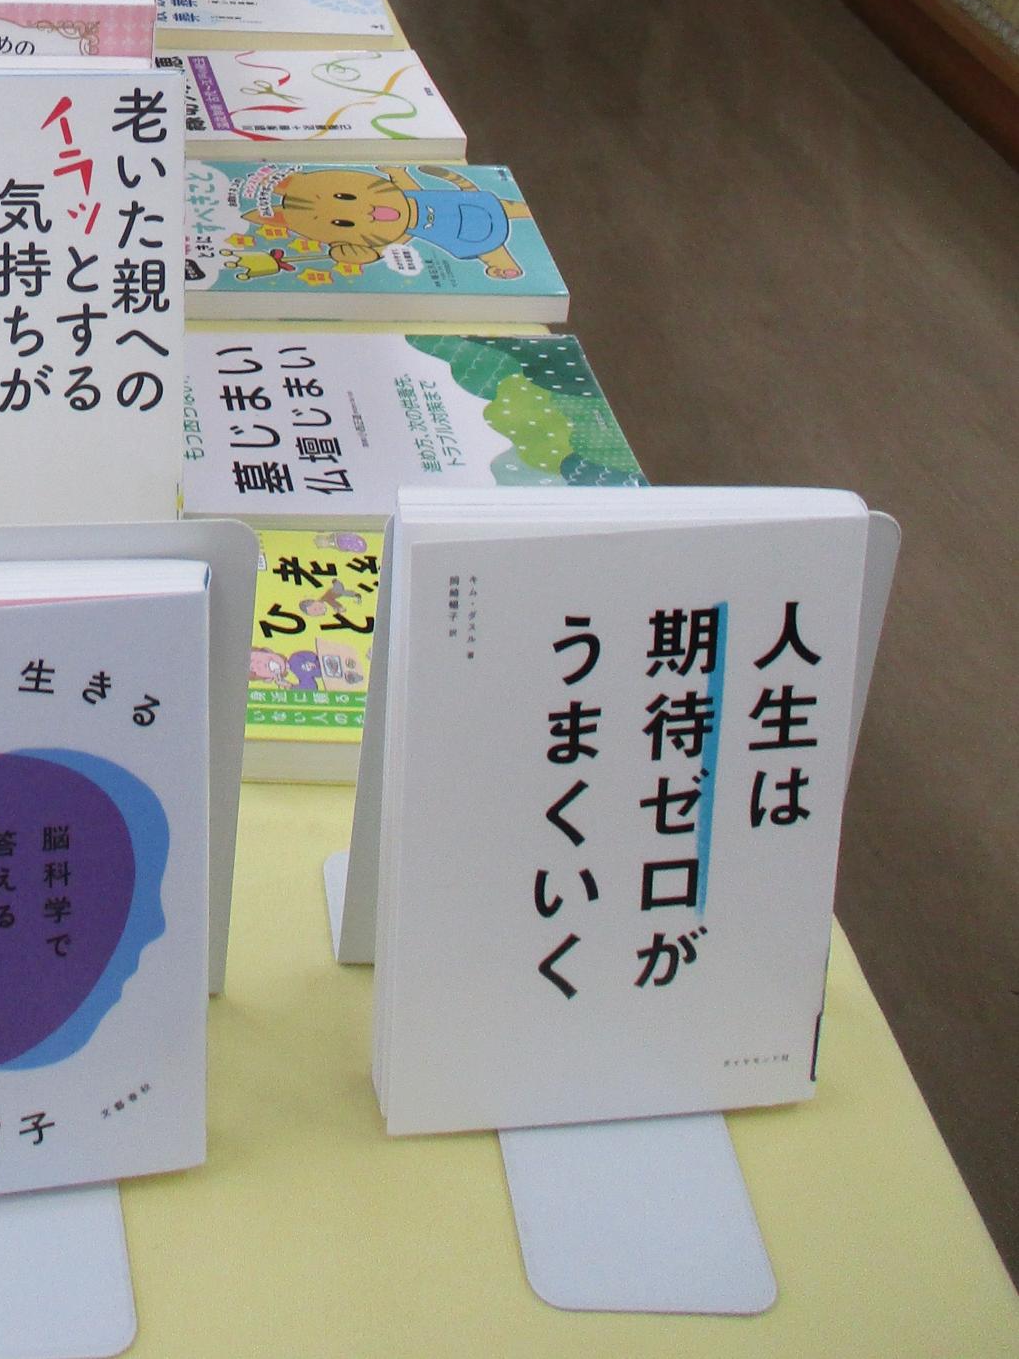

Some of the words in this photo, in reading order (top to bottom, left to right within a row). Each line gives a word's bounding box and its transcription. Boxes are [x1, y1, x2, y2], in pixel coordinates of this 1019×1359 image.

[40, 95, 108, 412] イラッとする
[111, 86, 170, 412] 老いた親への
[215, 346, 294, 496] 墓じまい
[278, 346, 354, 496] 仏壇じまい
[533, 614, 603, 1000] うまくいく
[633, 607, 720, 989] 期待ゼロが
[748, 601, 822, 829] 人生は
[41, 824, 73, 958] 脳科学で
